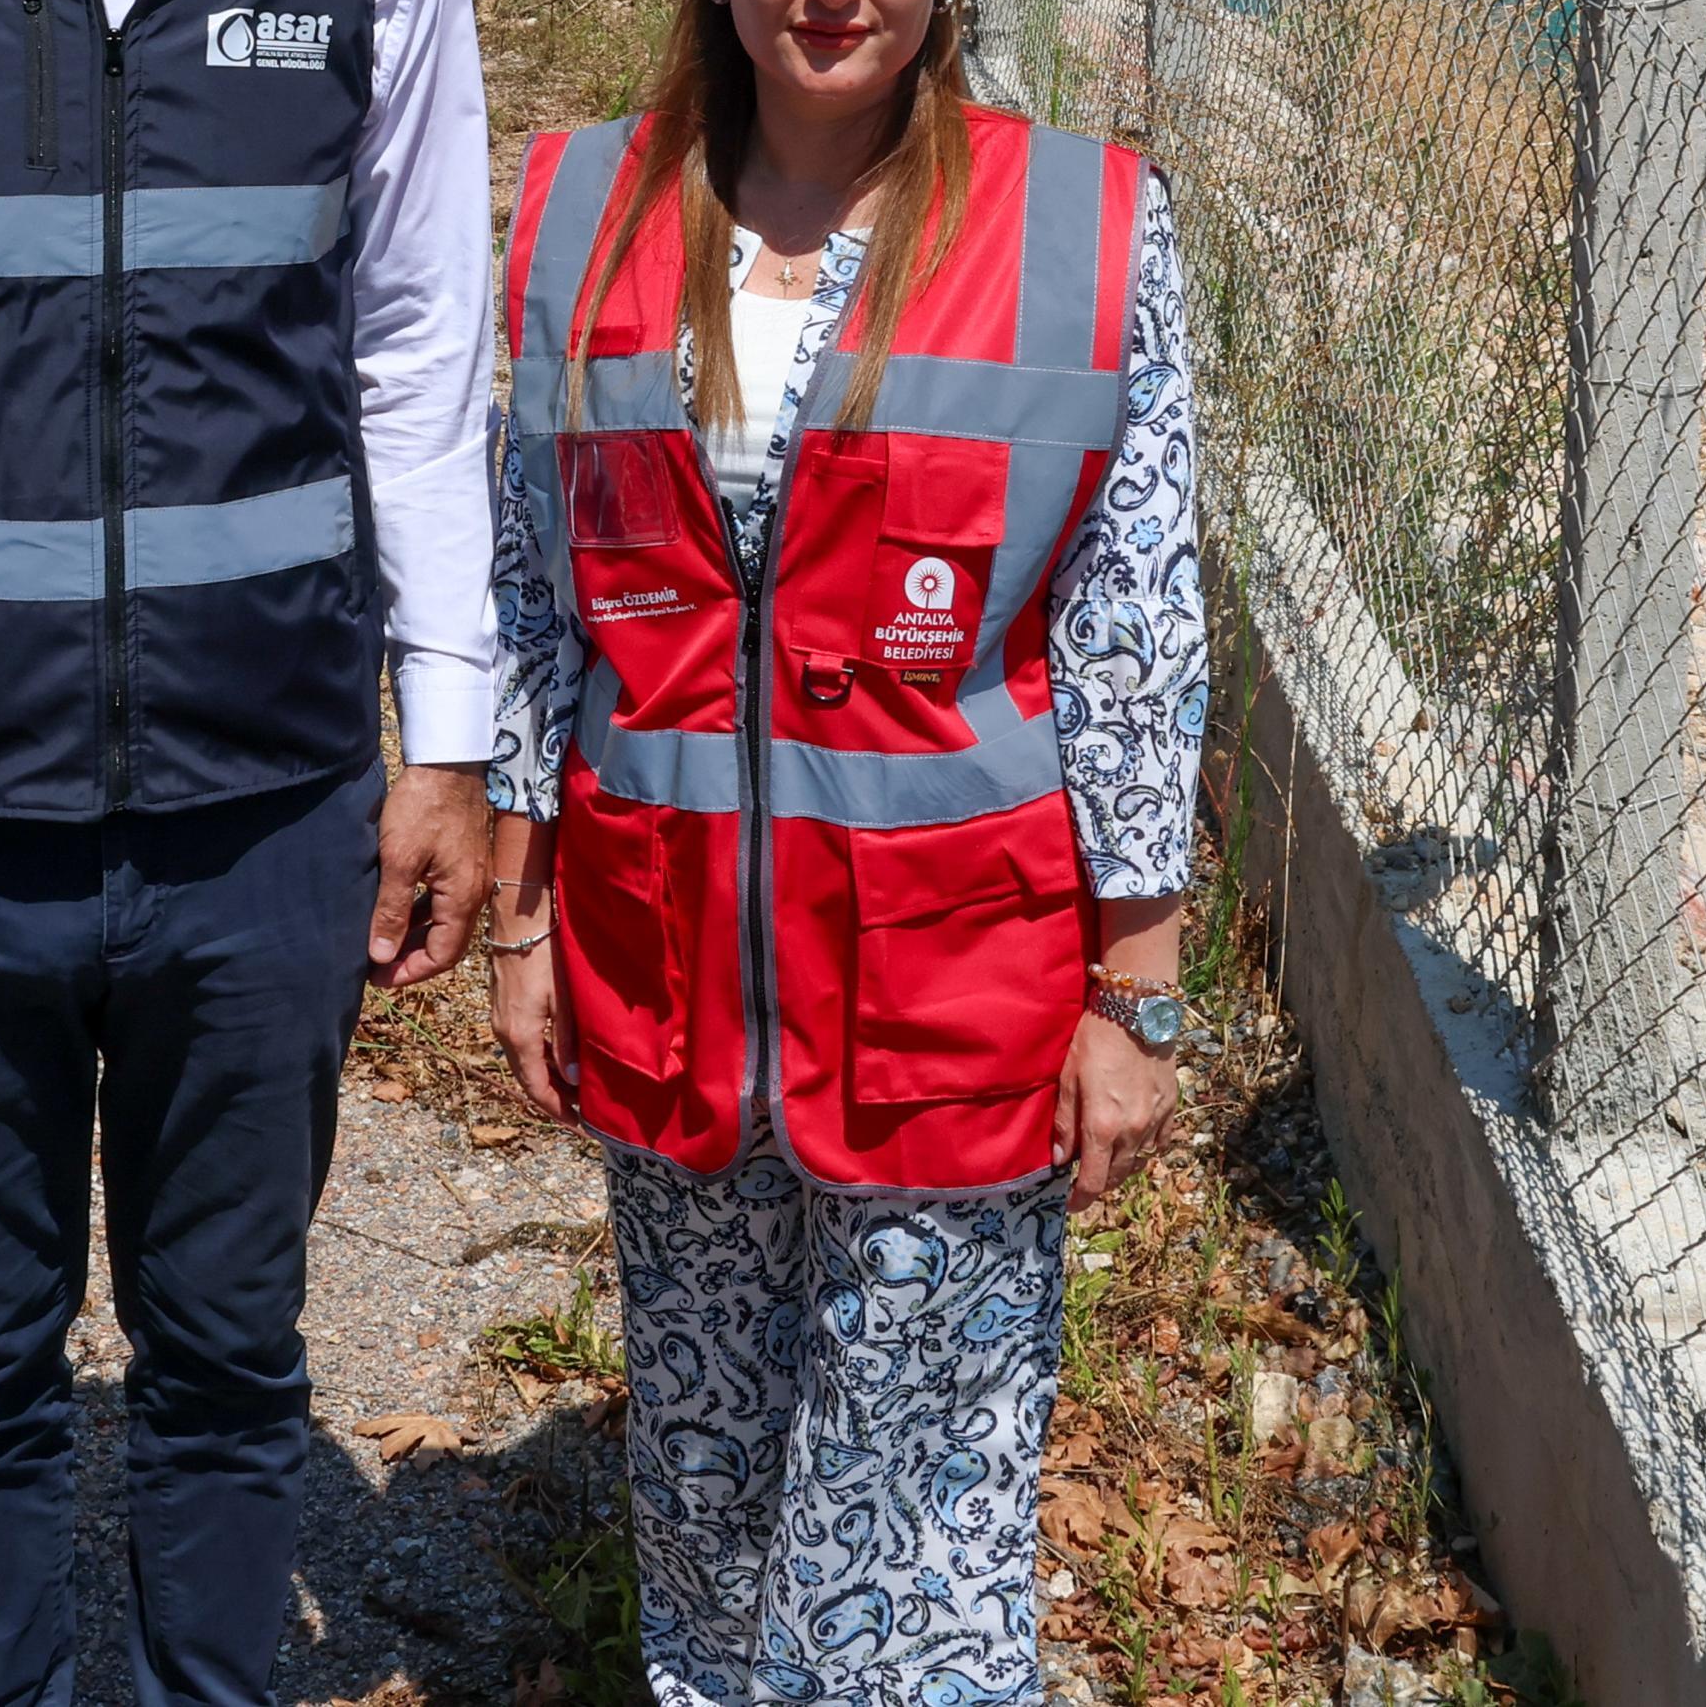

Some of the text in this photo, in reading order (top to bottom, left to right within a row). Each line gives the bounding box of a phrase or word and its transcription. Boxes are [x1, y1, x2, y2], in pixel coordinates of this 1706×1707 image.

[256, 11, 333, 44] asat
[591, 586, 679, 612] Büşra ÖZDEMİR
[893, 612, 954, 626] ANTALYA
[875, 625, 964, 646] BÜYÜKŞEHİR
[883, 644, 955, 660] BELEDİYESİ
